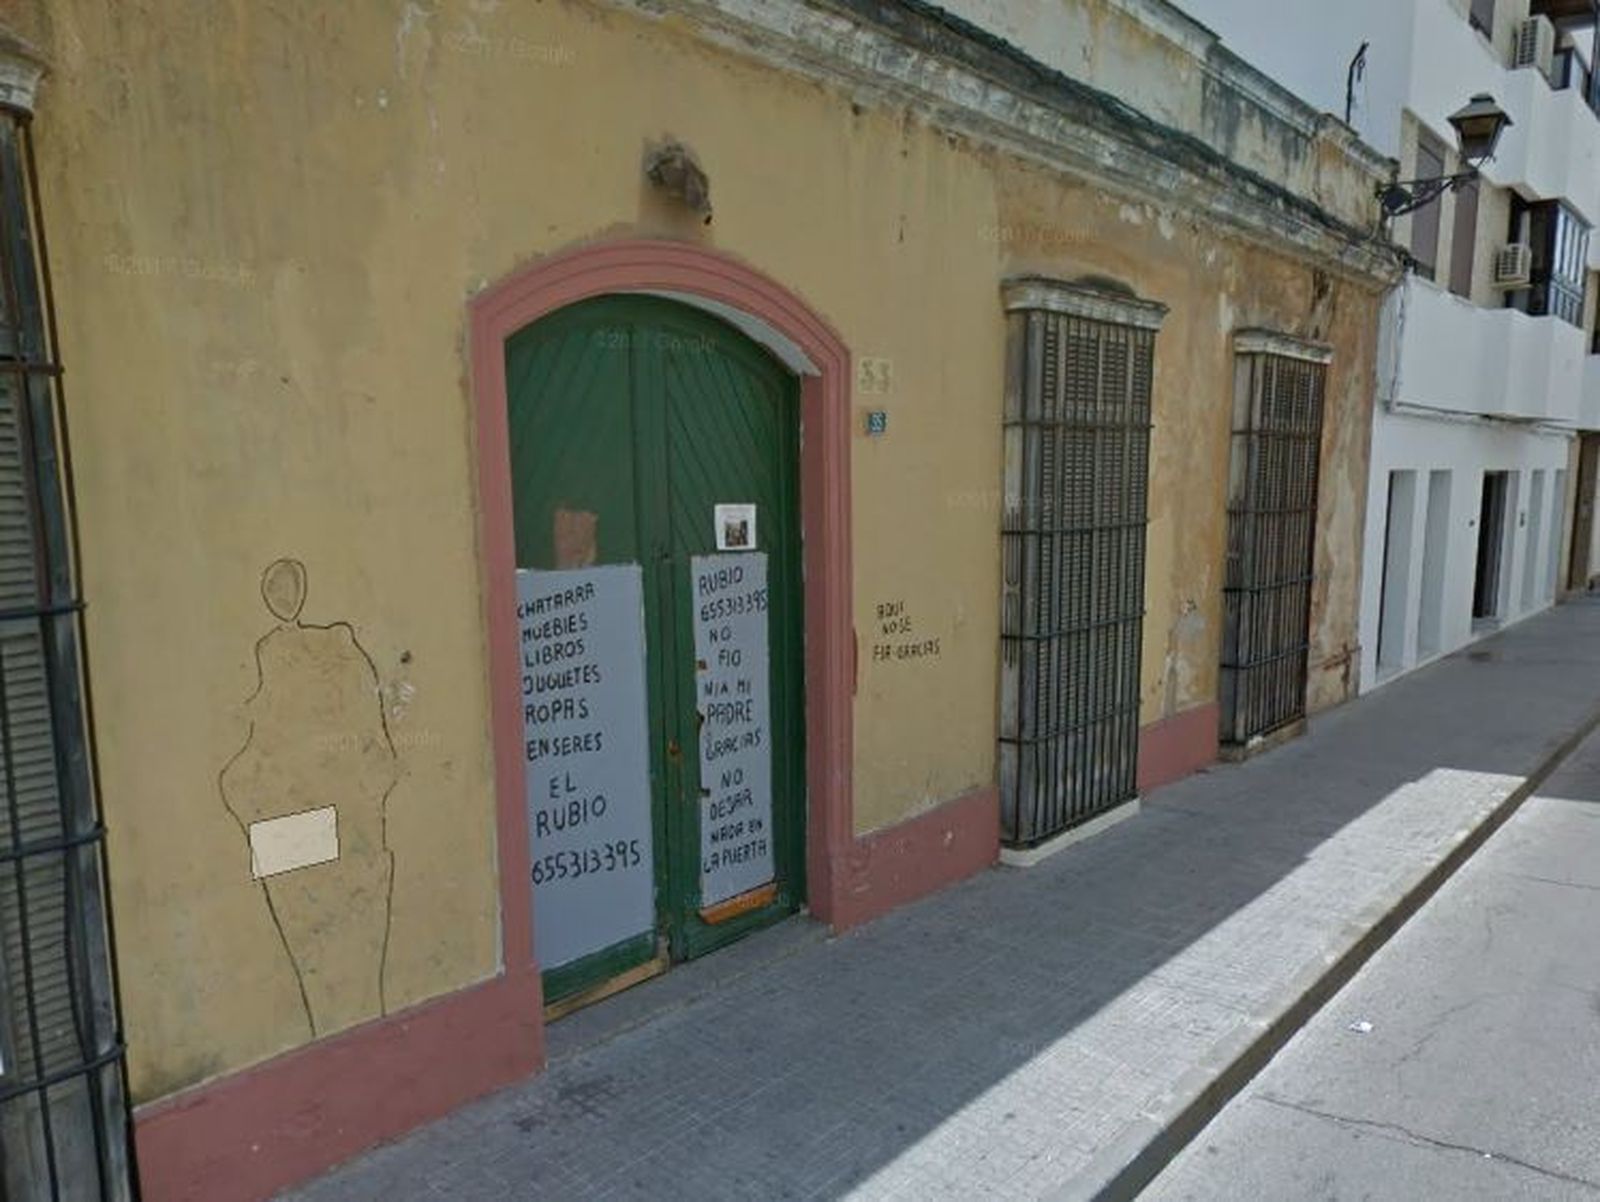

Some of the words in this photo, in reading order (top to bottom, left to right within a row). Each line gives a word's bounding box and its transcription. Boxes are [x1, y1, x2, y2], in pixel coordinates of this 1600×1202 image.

[699, 566, 744, 597] RUBIO
[517, 582, 595, 619] CHATARRA
[700, 588, 768, 622] 655313395
[709, 626, 731, 644] NO
[525, 638, 585, 668] LIBROS
[718, 650, 742, 667] FIO
[525, 698, 589, 725] ROPAS
[706, 699, 753, 725] PADRE
[527, 732, 603, 762] ENSERES
[705, 727, 762, 761] GRACIAS
[549, 769, 577, 799] EL
[720, 768, 743, 789] NO
[536, 795, 607, 838] RUBIO
[532, 839, 641, 885] 655313395
[703, 853, 719, 873] LA
[722, 839, 767, 867] PUERTA
